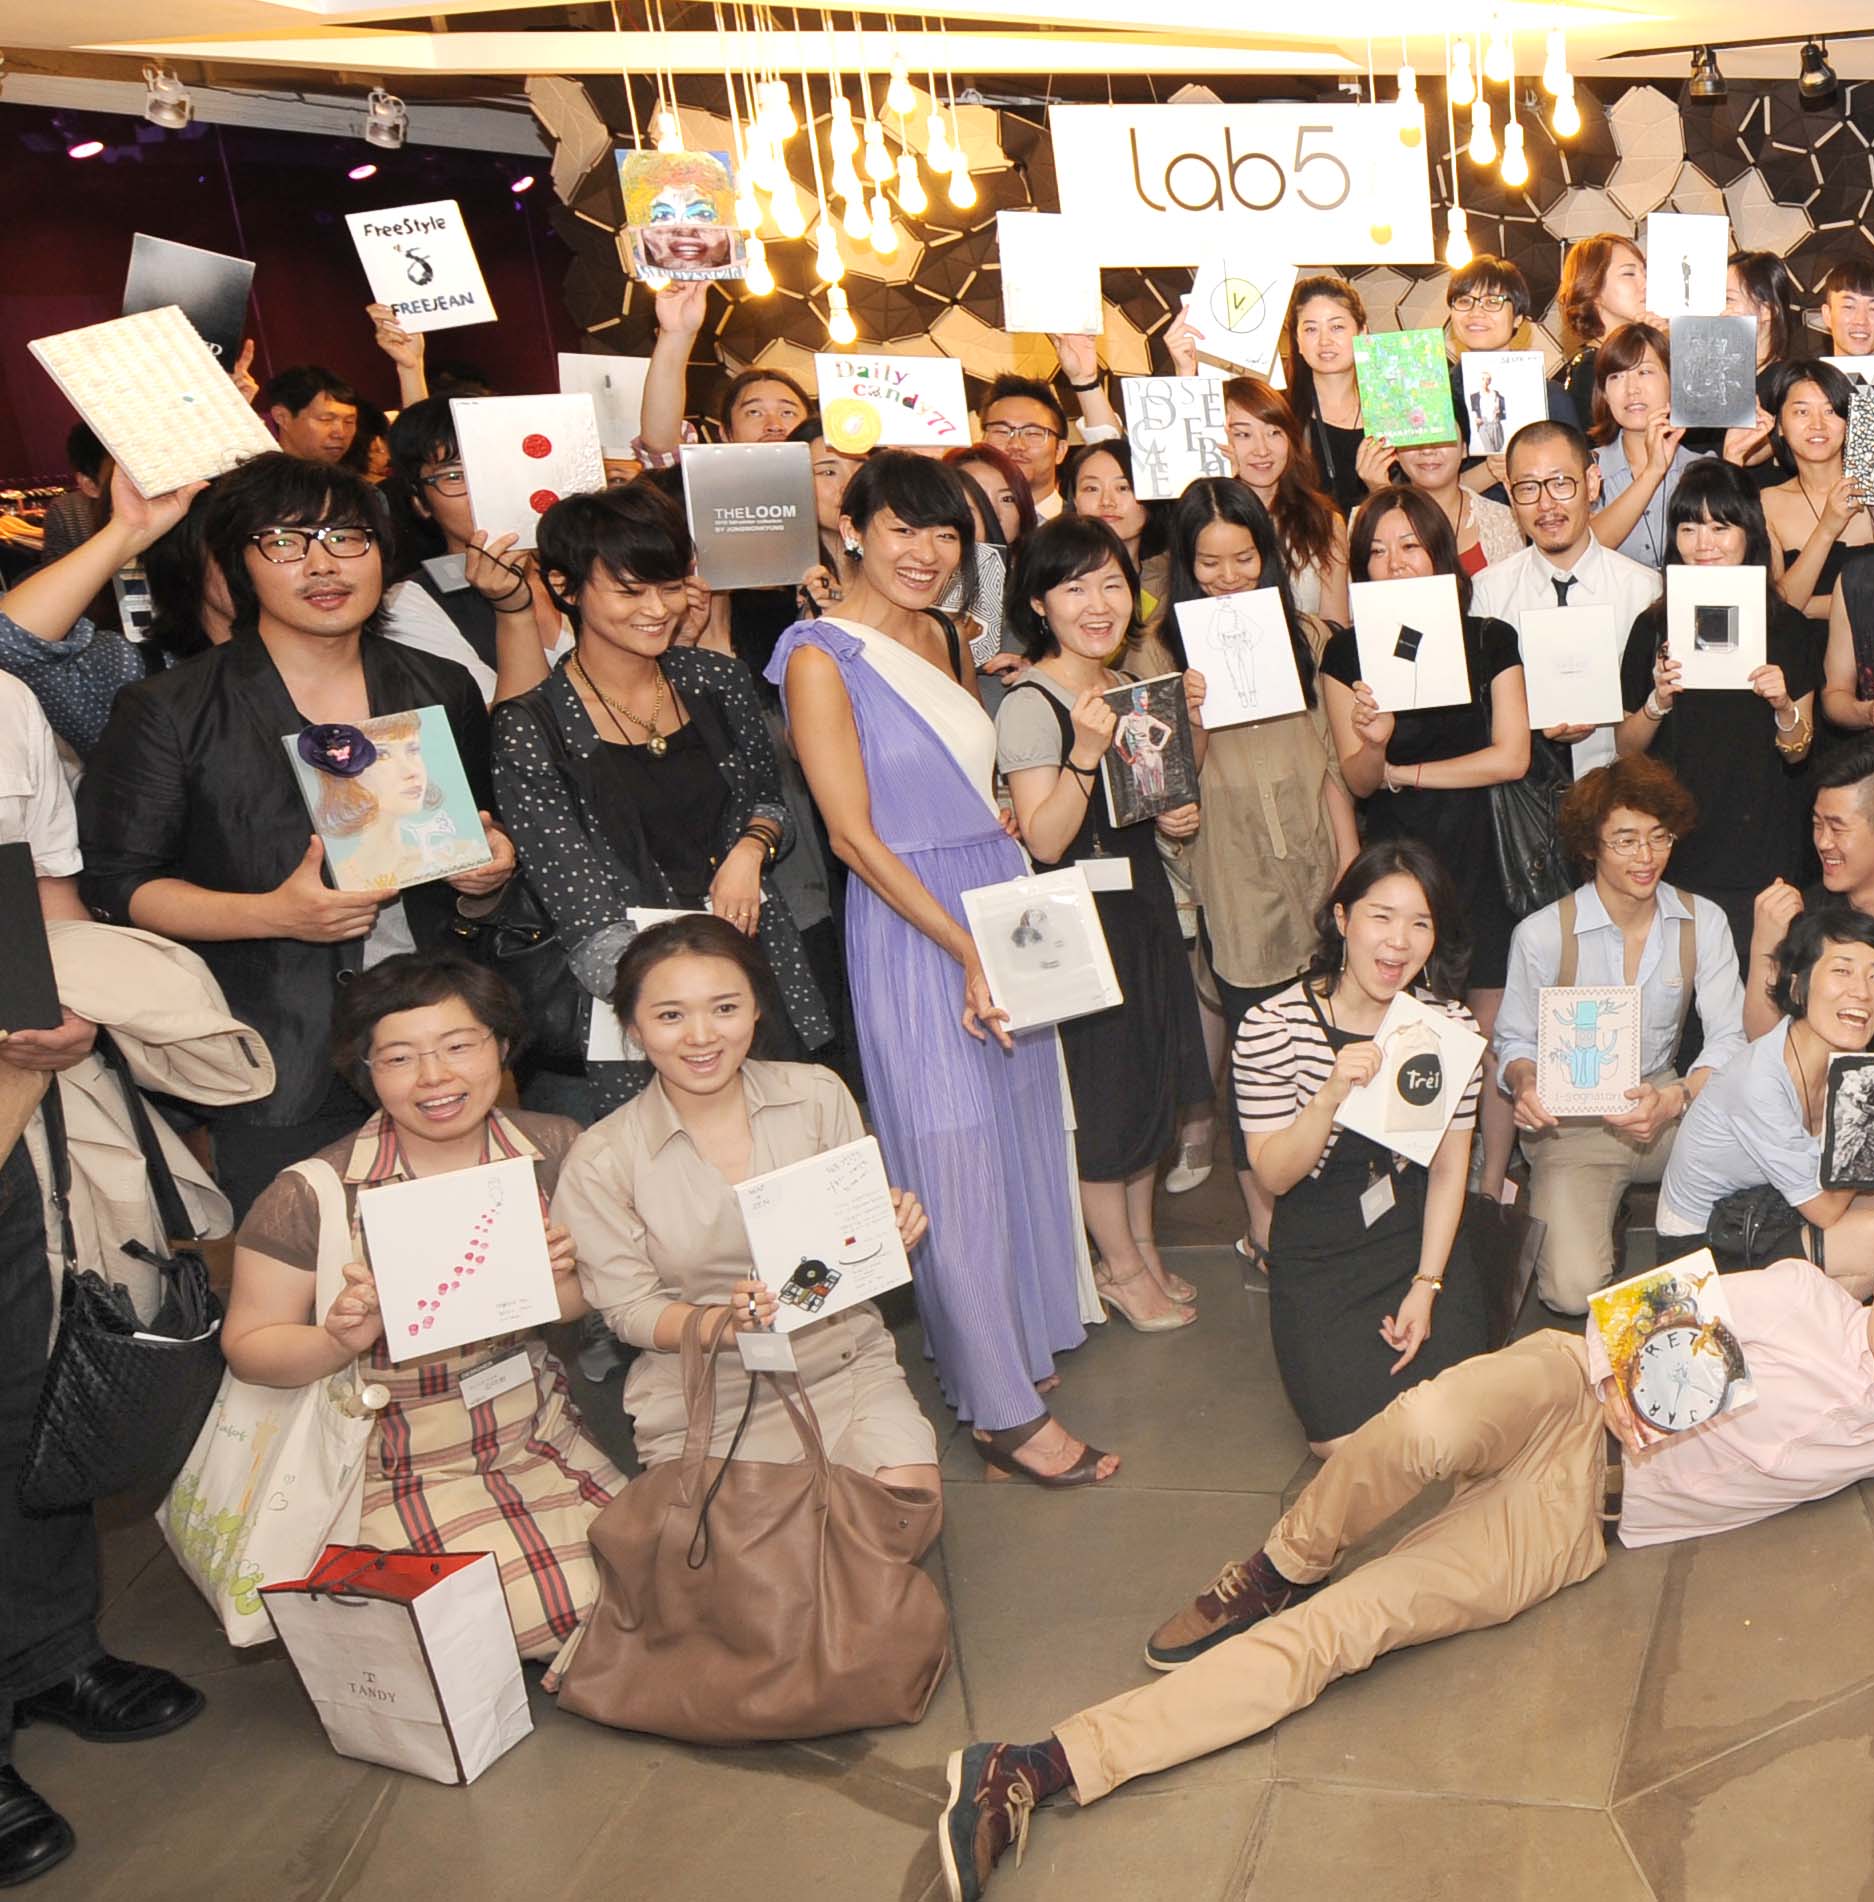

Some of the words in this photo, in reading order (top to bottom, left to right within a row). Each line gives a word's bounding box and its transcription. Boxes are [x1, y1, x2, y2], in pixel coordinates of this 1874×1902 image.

[1129, 125, 1351, 212] lab5
[363, 216, 447, 237] FreeStyle
[391, 291, 475, 316] FREEJEAN
[835, 360, 909, 385] Daily
[347, 1682, 397, 1703] TANDY
